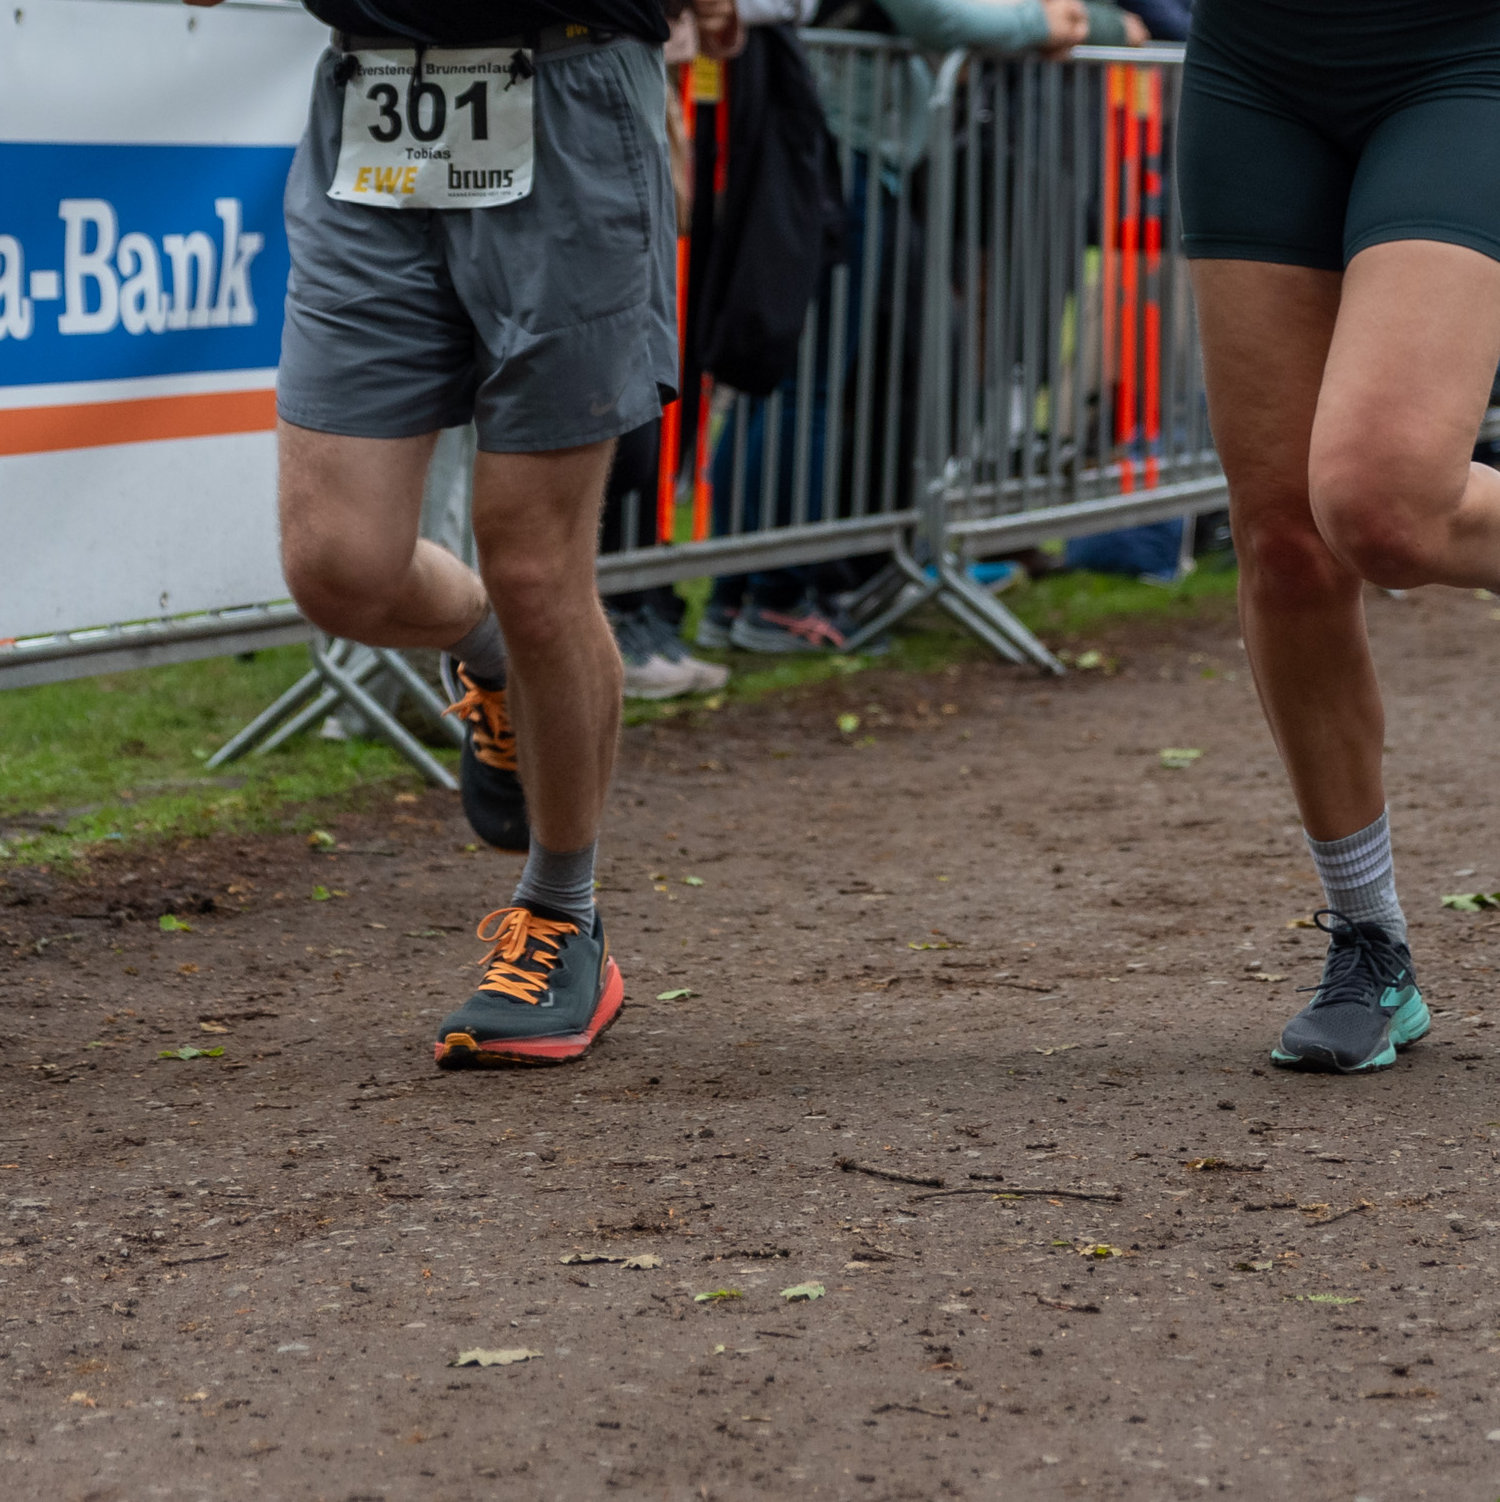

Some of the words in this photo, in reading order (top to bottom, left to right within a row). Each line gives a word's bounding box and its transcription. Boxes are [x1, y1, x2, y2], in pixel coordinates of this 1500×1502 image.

[357, 64, 419, 76] Everstene
[426, 63, 513, 75] Brunnenlau
[366, 81, 488, 143] 301
[405, 148, 451, 160] Tobias
[353, 166, 419, 194] EWE
[448, 163, 514, 189] bruns
